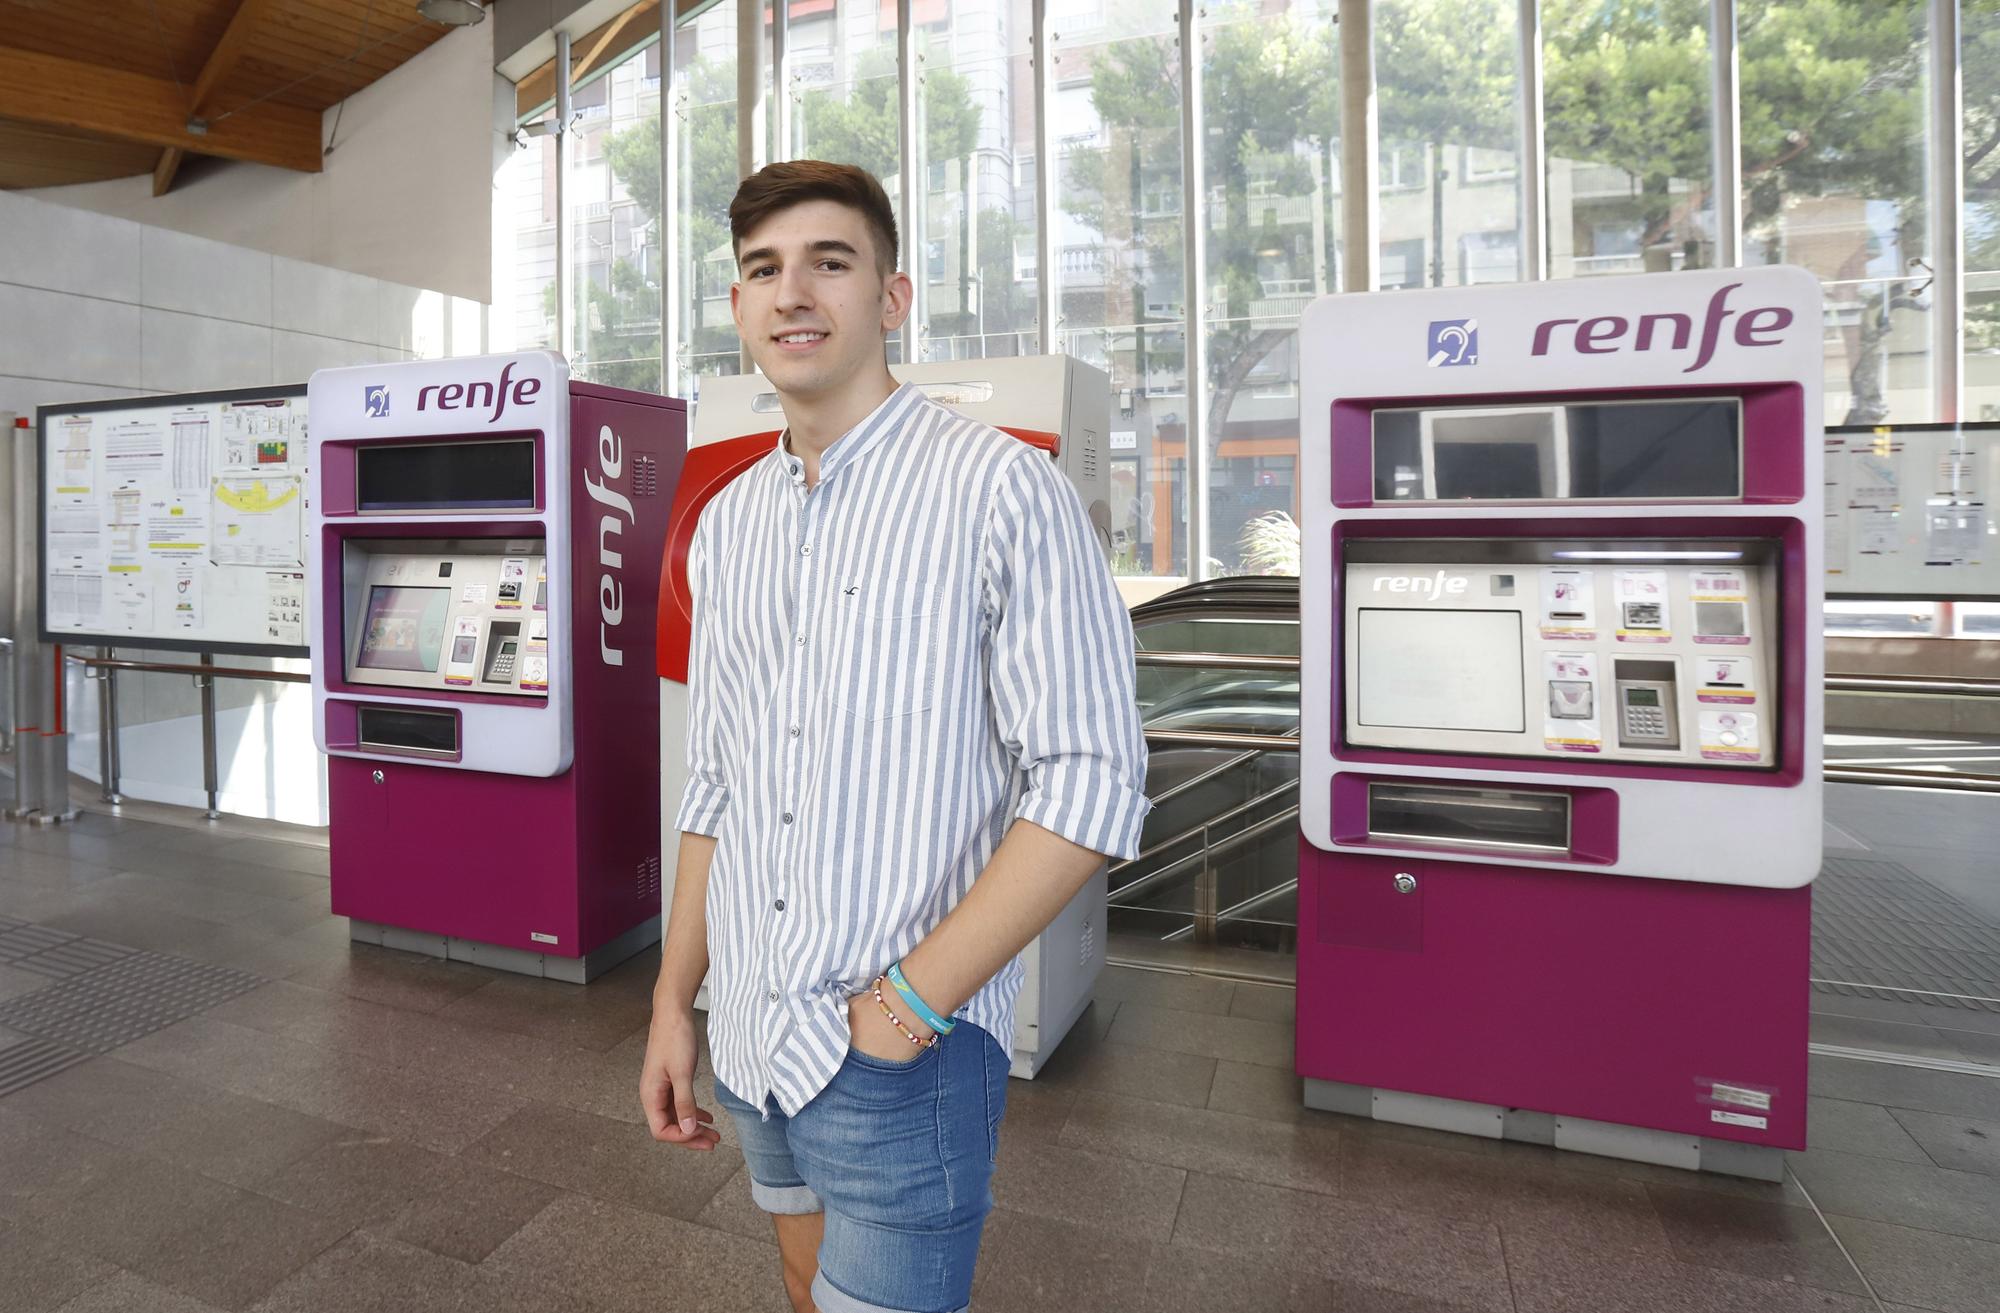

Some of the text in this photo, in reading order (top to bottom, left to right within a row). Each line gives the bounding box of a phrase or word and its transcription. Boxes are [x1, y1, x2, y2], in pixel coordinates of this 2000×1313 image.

[1531, 283, 1794, 373] renfe
[417, 361, 541, 424] renfe
[584, 425, 635, 666] renfe
[1373, 570, 1469, 601] renfe
